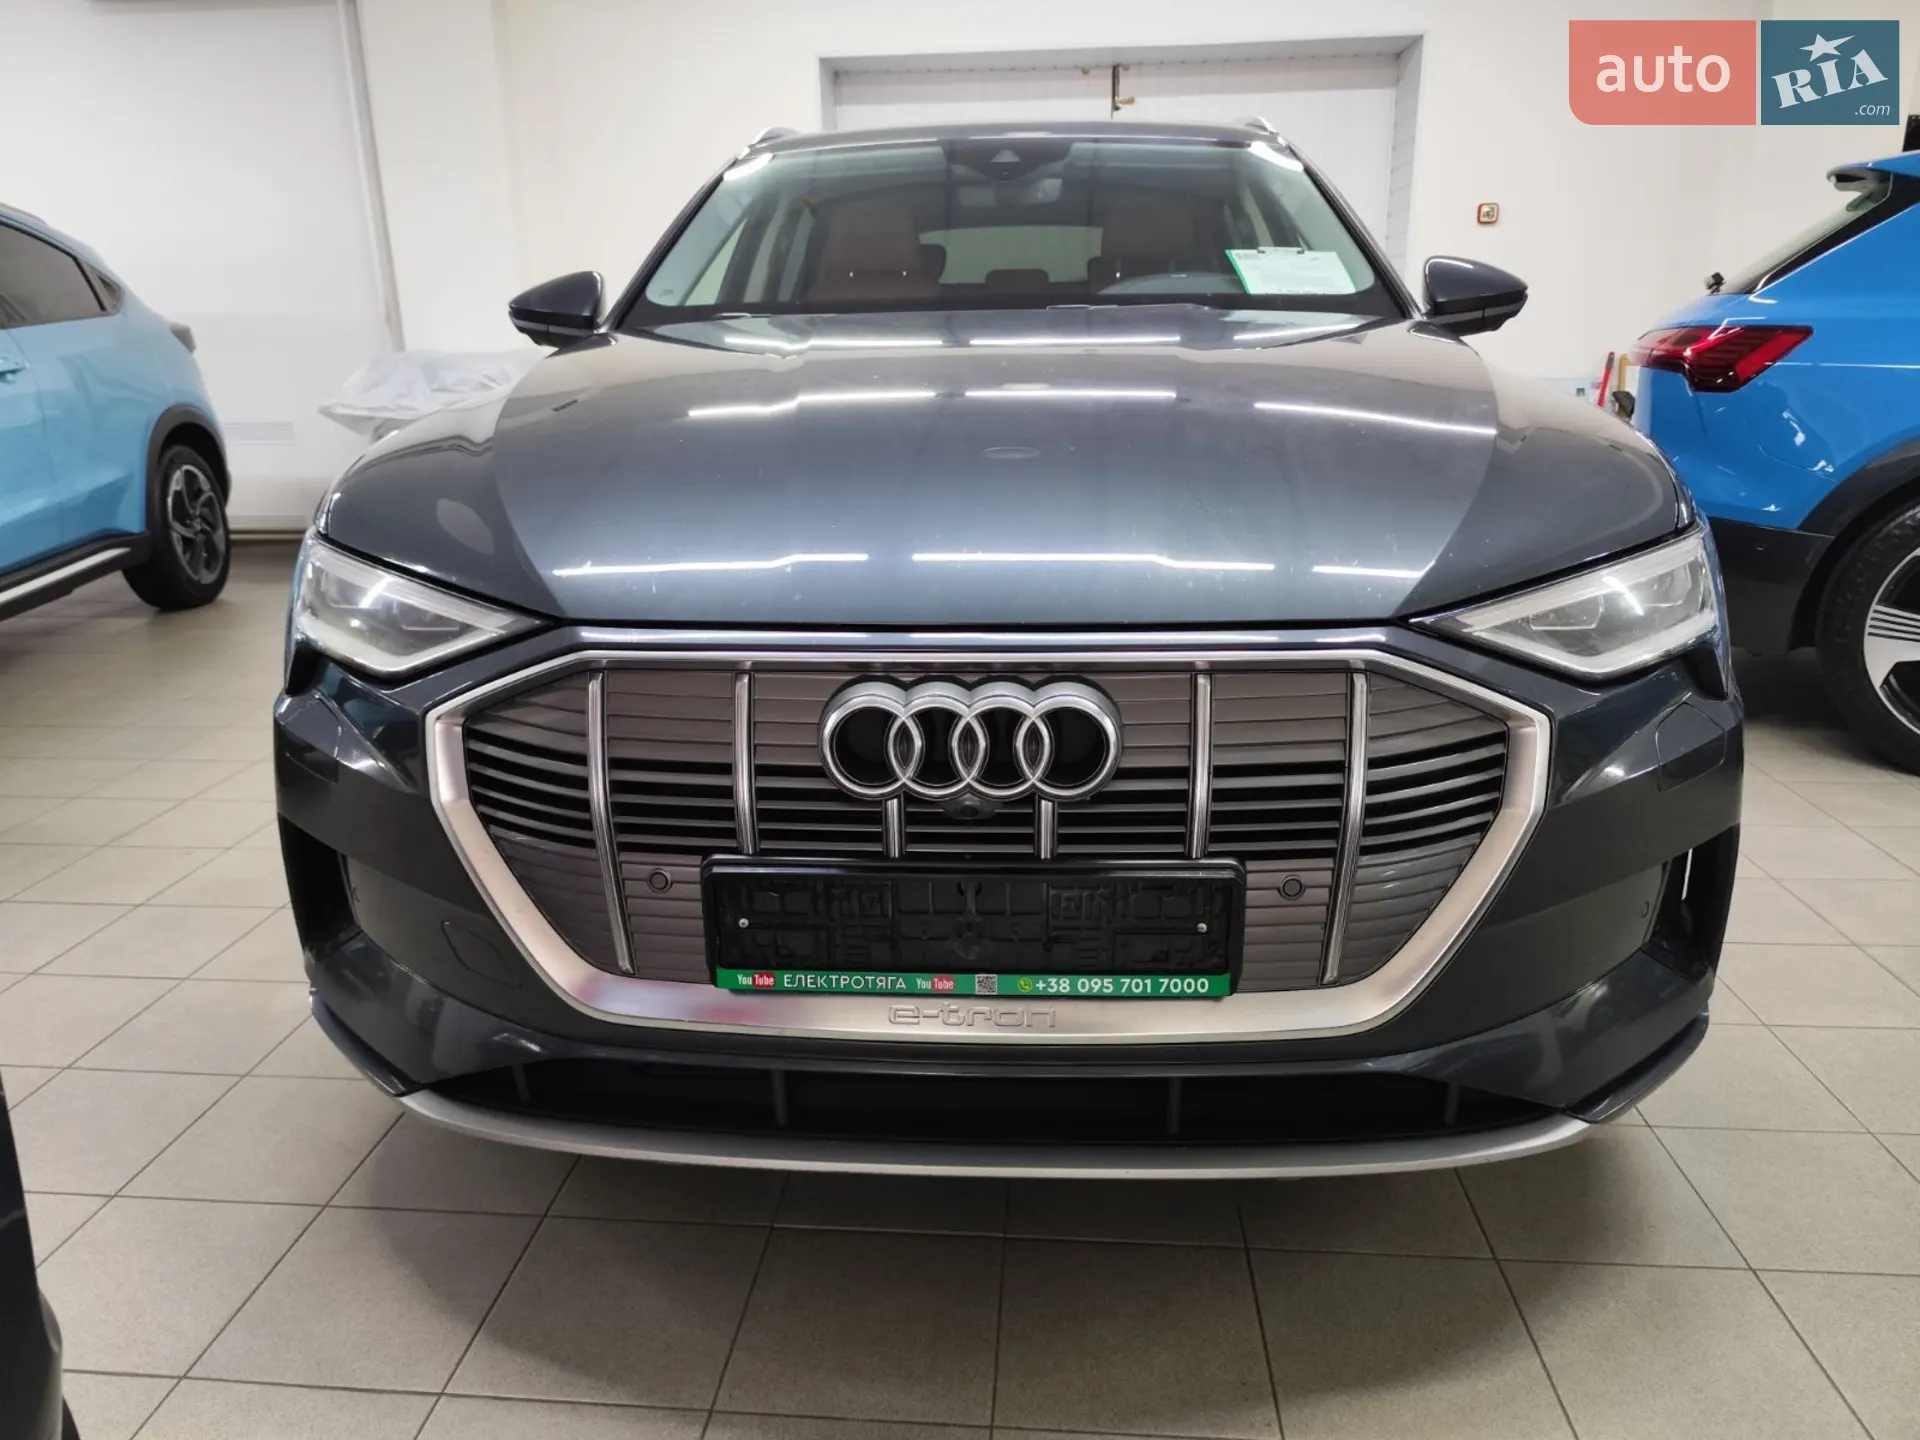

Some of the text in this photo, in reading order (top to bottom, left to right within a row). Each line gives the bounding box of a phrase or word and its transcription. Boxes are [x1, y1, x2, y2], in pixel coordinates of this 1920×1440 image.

[783, 974, 907, 990] ЕЛЕКТРОТЯГА
[1035, 978, 1209, 993] +38 095 701 7000
[888, 1002, 1056, 1028] e-tron
